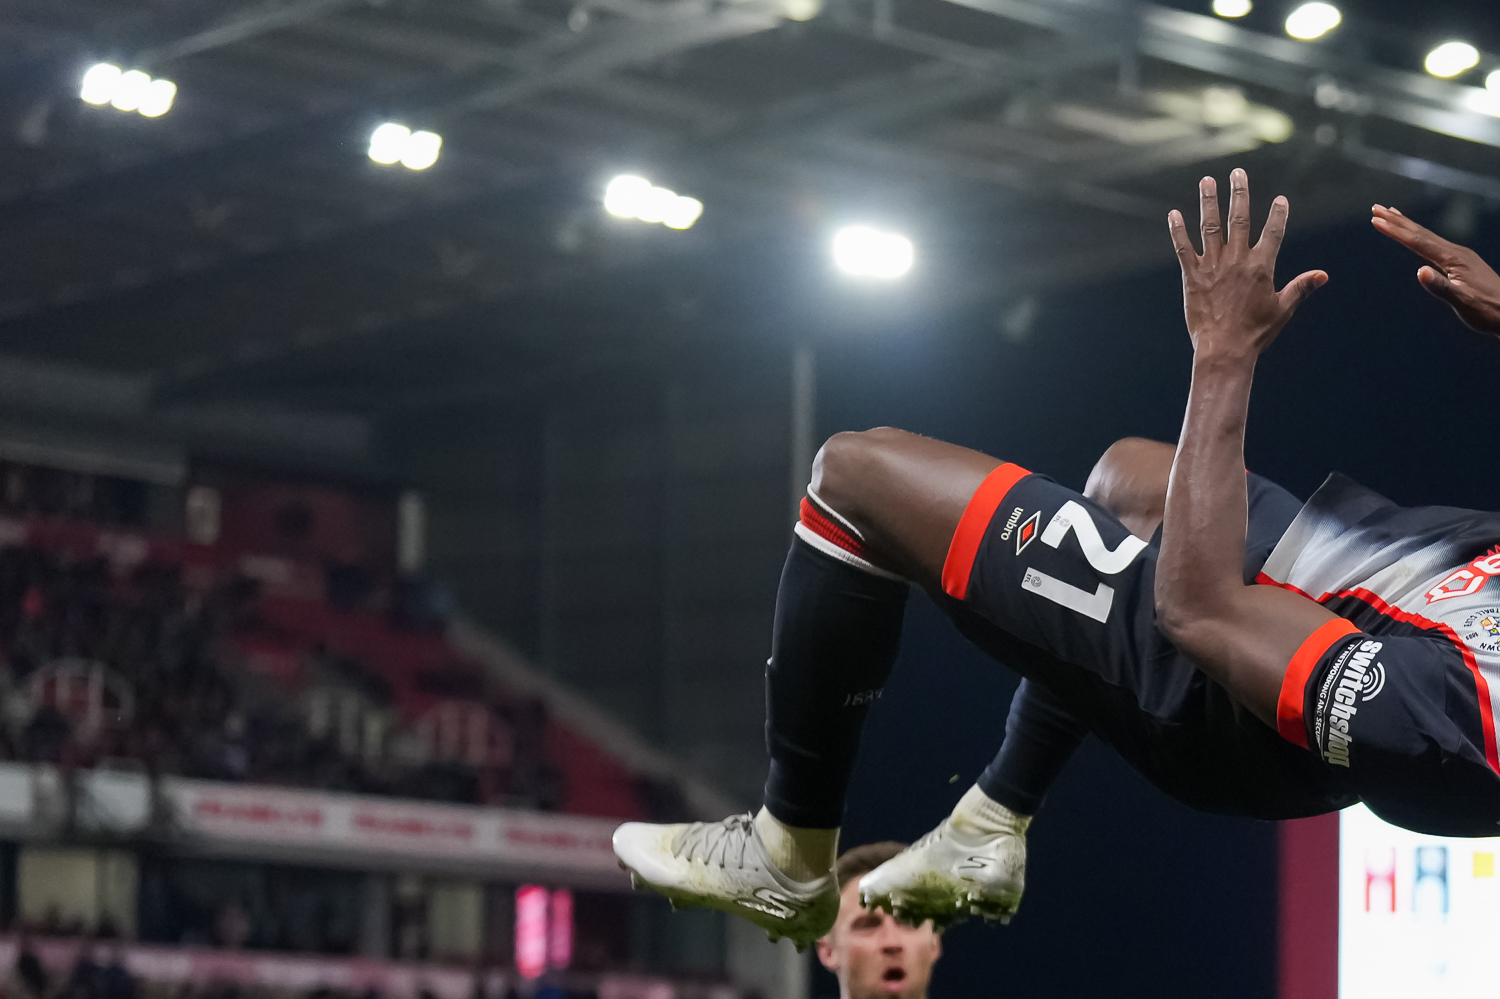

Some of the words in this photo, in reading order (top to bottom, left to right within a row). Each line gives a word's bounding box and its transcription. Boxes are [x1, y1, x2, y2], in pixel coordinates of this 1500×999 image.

[1000, 506, 1025, 541] umbro
[1021, 499, 1149, 624] 21
[1024, 573, 1032, 583] EFL
[1320, 650, 1349, 699] NETWORKING
